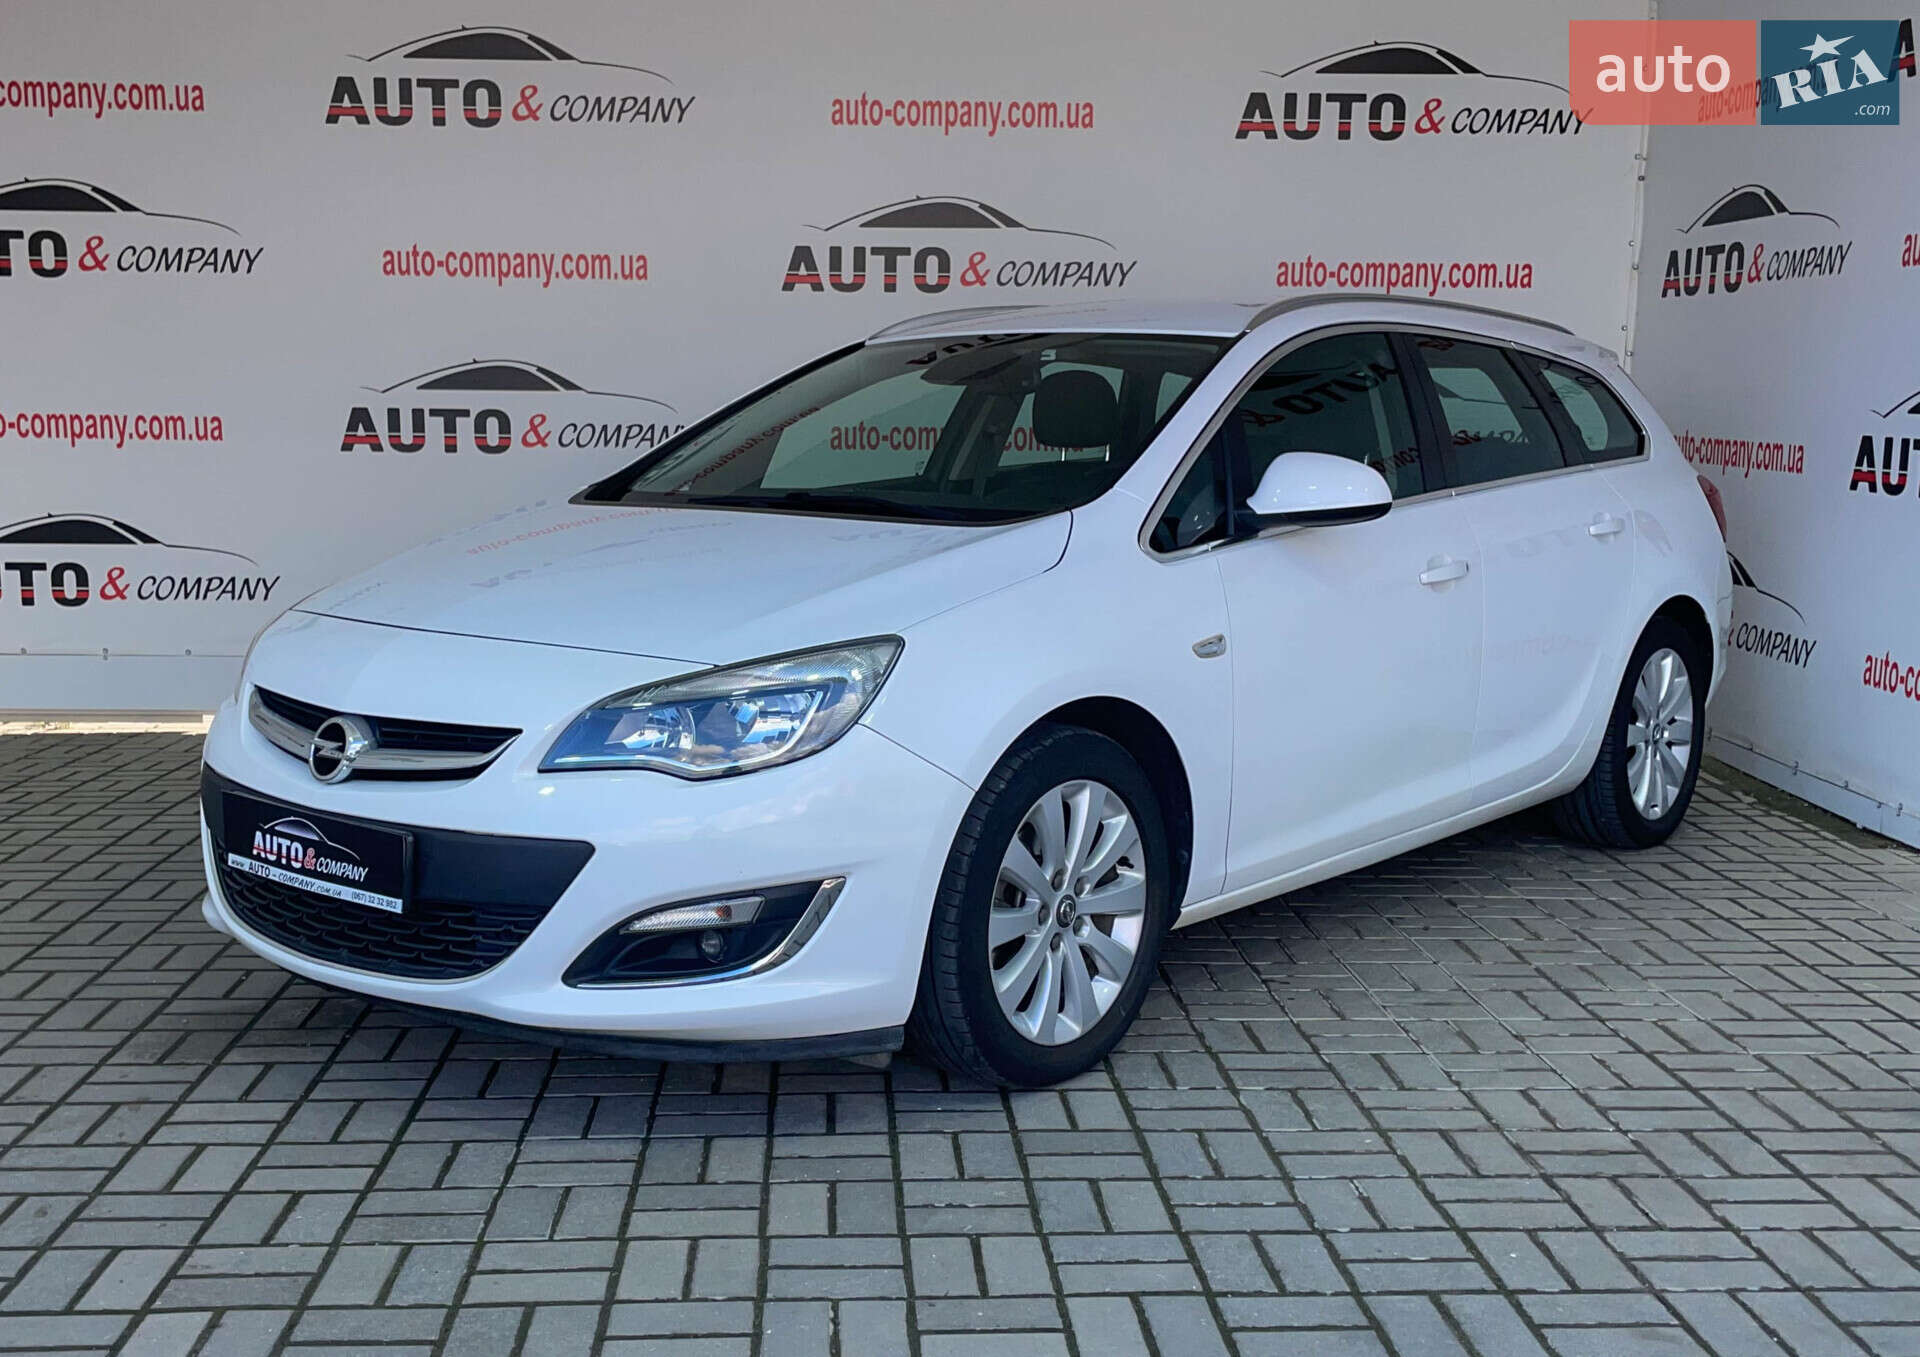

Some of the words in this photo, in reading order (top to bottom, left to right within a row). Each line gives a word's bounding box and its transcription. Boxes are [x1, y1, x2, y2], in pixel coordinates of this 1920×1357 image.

[325, 76, 502, 128] AUTO
[511, 84, 543, 121] &
[550, 95, 695, 124] COMPANY
[831, 92, 1094, 136] auto-company.com.ua
[1235, 92, 1407, 141] AUTO
[1414, 98, 1445, 135] &
[1451, 107, 1594, 136] COMPANY
[78, 235, 110, 272] &
[117, 245, 264, 274] COMPANY
[382, 243, 648, 288] auto-company.com.ua
[781, 245, 950, 294] AUTO
[960, 251, 990, 287] &
[996, 260, 1138, 288] COMPANY
[1276, 255, 1533, 297] auto-company.com.ua
[1661, 242, 1744, 298] AUTO
[1747, 243, 1765, 283] &
[1767, 241, 1852, 282] COMPANY
[340, 406, 511, 455] AUTO
[521, 413, 552, 449] &
[558, 423, 685, 449] COMPAN
[1674, 429, 1805, 478] uto-company.com.ua
[100, 566, 130, 601] &
[137, 575, 280, 601] COMPANY
[1736, 622, 1817, 669] COMPANY
[252, 830, 303, 869] AUTO
[304, 848, 316, 870] &
[316, 857, 369, 882] COMPANY
